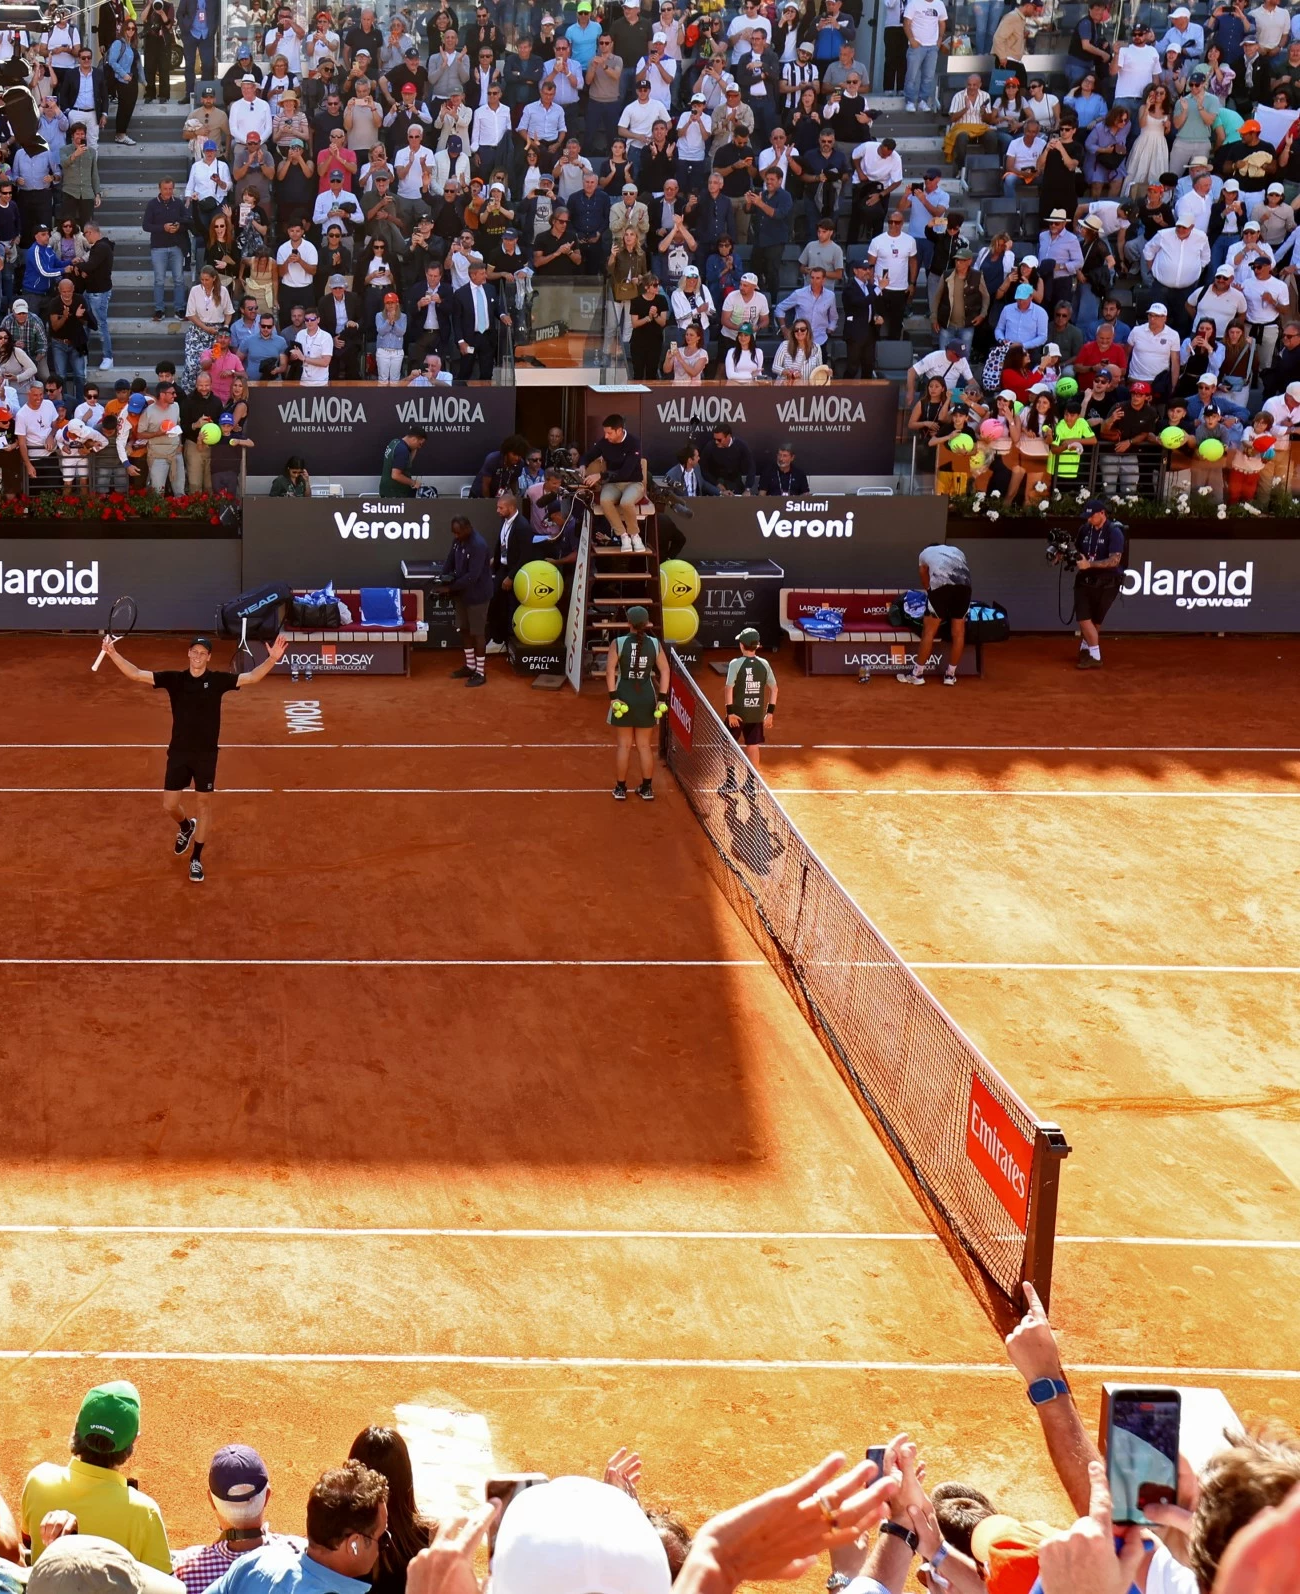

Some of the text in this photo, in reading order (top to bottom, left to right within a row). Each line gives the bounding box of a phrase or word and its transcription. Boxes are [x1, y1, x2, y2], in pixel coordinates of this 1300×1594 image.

[278, 396, 367, 423] VALMORA
[396, 396, 485, 423] VALMORA
[657, 396, 747, 423] VALMORA
[776, 395, 866, 423] VALMORA
[362, 502, 405, 514] Salumi
[785, 501, 829, 512] Salumi
[334, 511, 431, 540] Veroni
[756, 510, 855, 538] Veroni
[1119, 561, 1254, 596] olaroid
[27, 595, 99, 608] eyewear
[237, 593, 279, 617] HEAD
[705, 589, 746, 608] ITA
[1175, 597, 1252, 610] eyewear
[291, 654, 334, 665] ROCHE
[334, 654, 374, 665] POSAY
[844, 654, 860, 665] LA
[861, 654, 903, 665] ROCHE
[283, 700, 325, 735] ROMA
[970, 1099, 1026, 1199] Emirates
